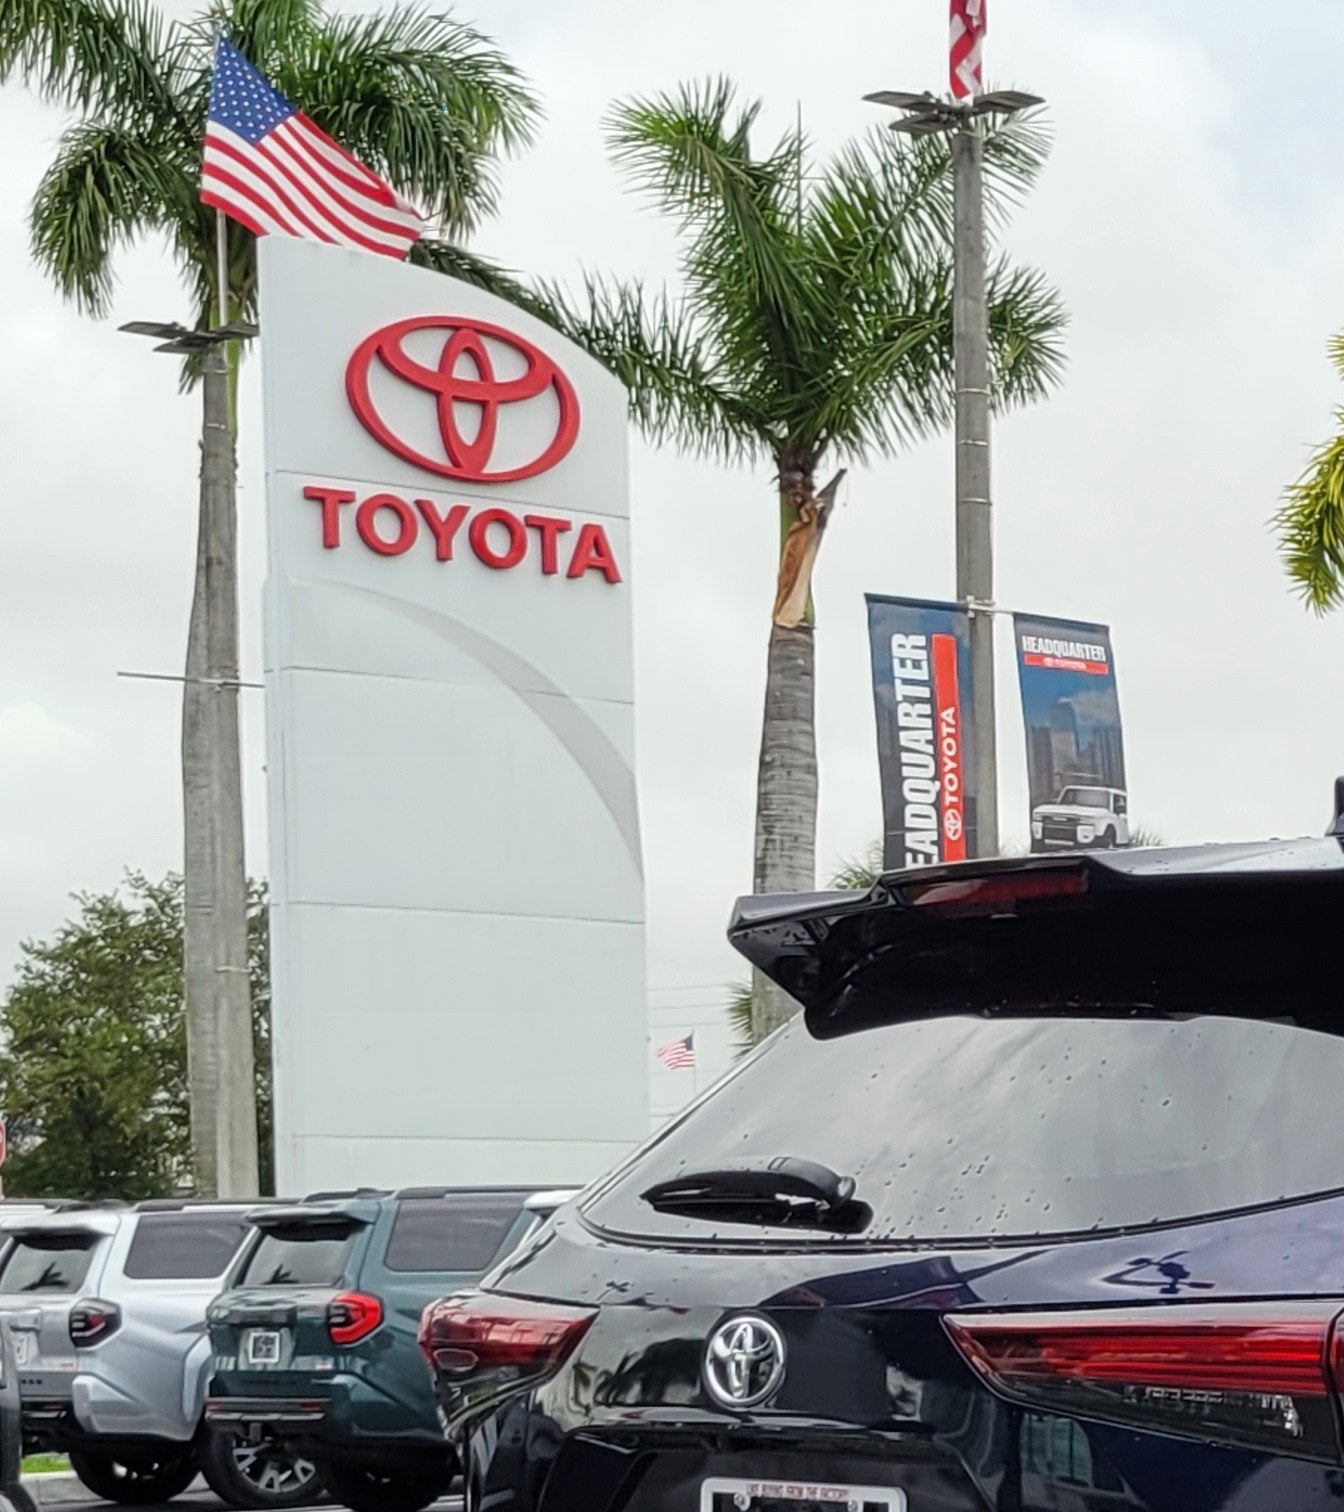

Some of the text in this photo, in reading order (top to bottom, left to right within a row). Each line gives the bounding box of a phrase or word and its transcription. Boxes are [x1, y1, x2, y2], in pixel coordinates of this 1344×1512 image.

[304, 486, 622, 584] TOYOTA
[1021, 634, 1107, 662] HEADQUARTER
[891, 633, 940, 868] EADQUARTER
[939, 707, 958, 801] TOYOTA
